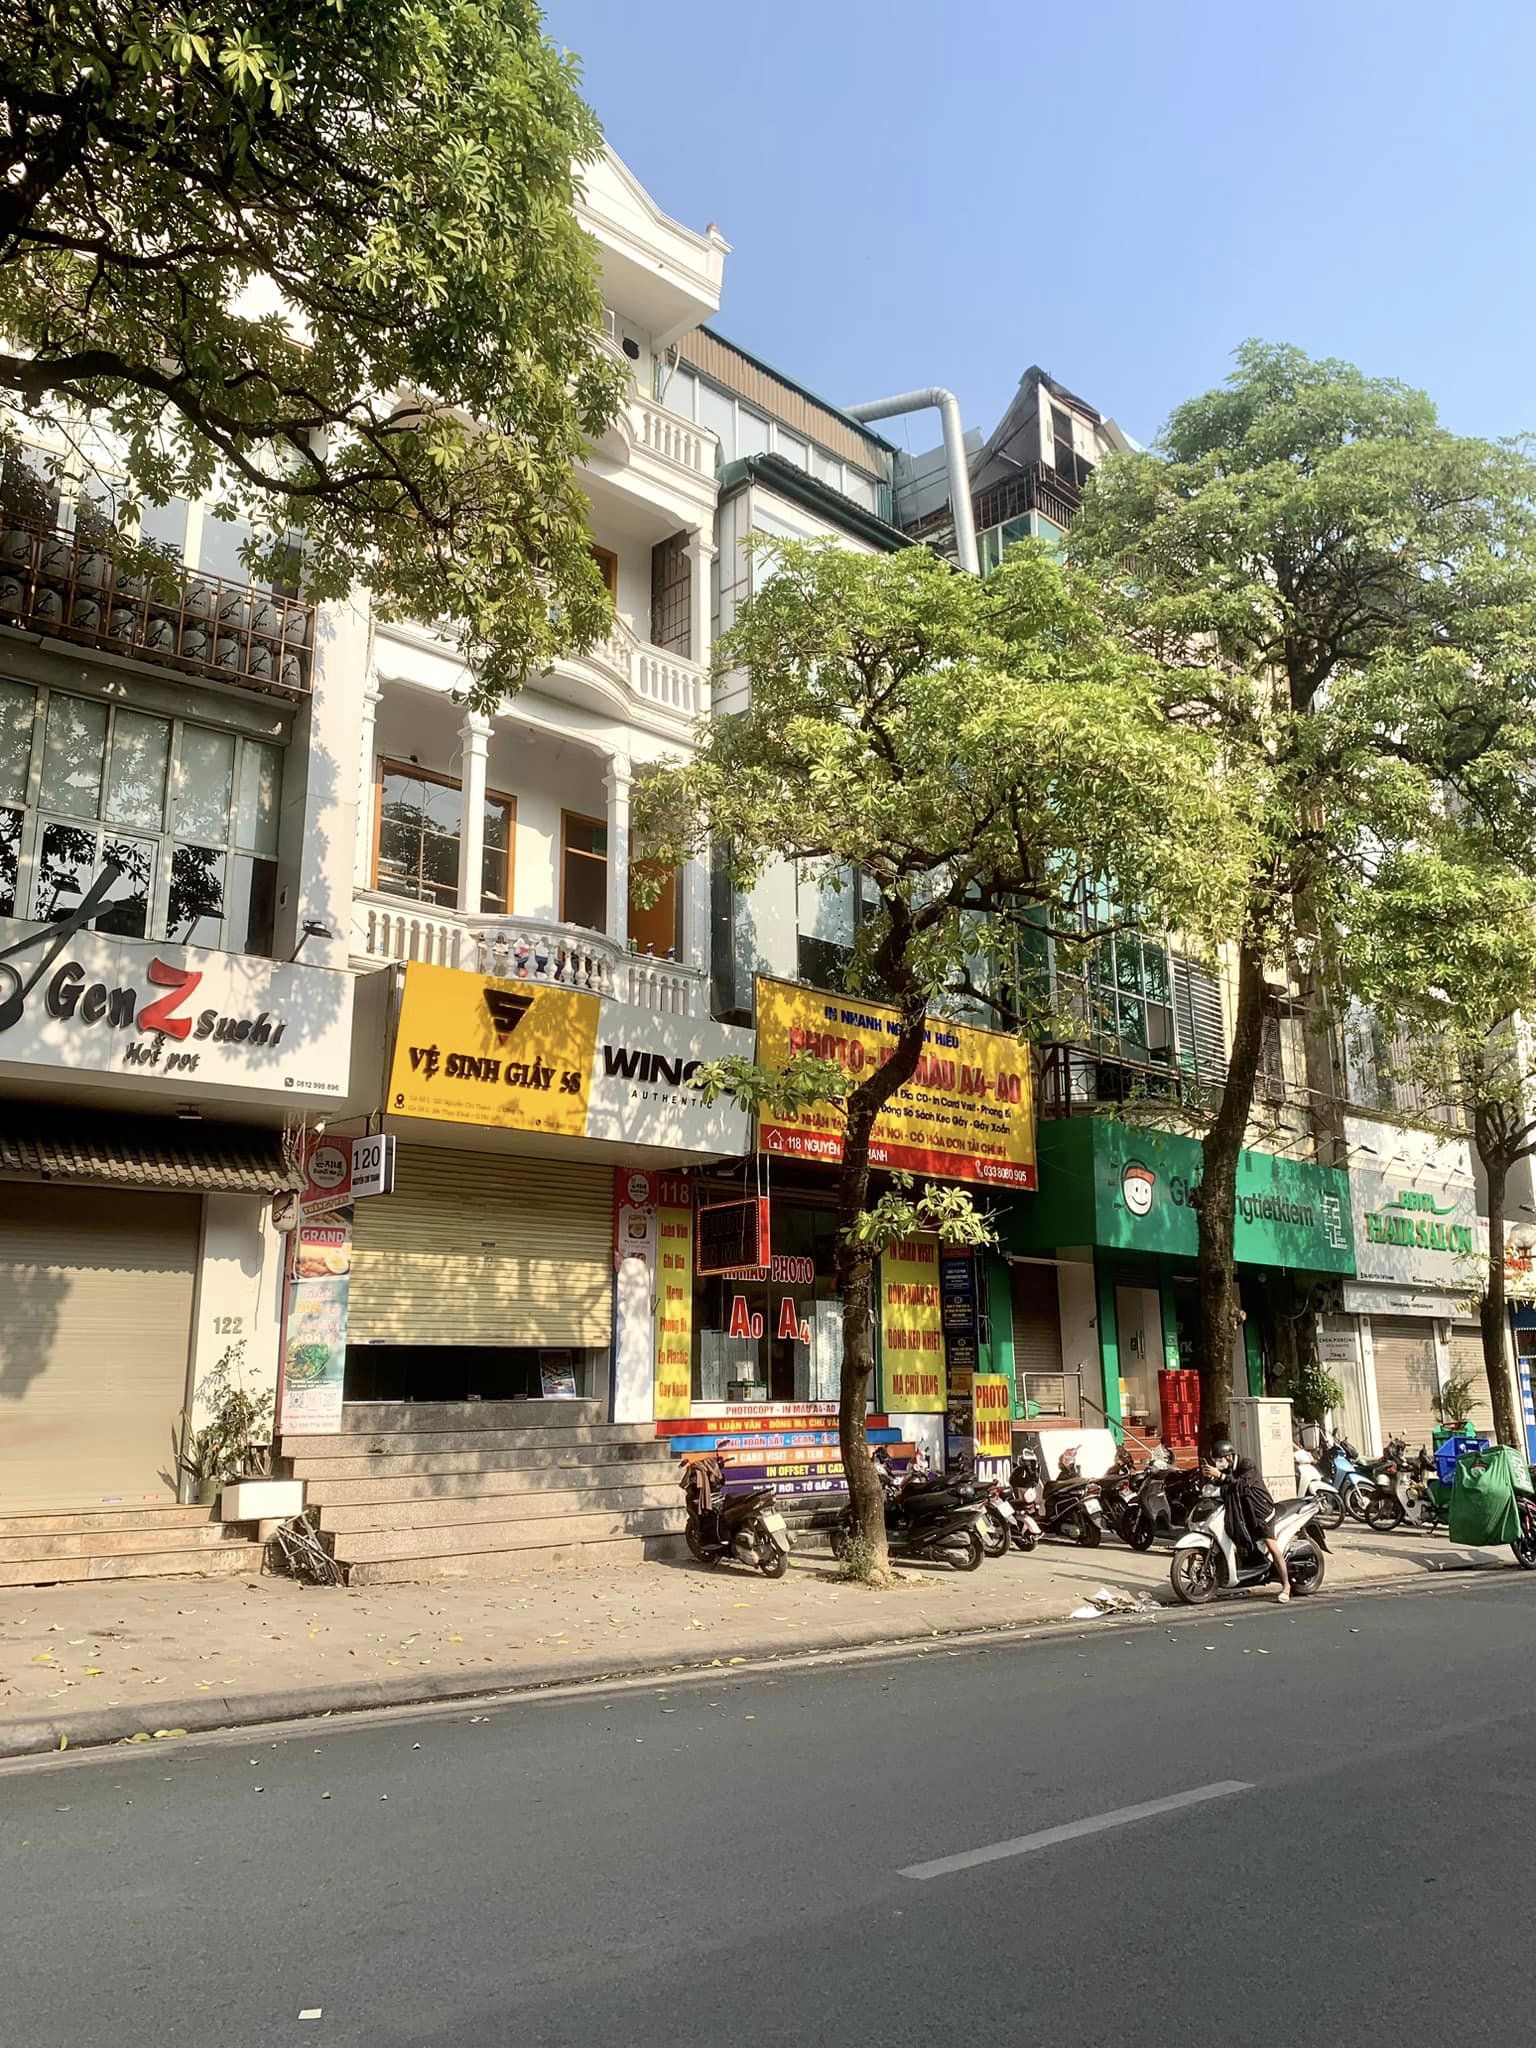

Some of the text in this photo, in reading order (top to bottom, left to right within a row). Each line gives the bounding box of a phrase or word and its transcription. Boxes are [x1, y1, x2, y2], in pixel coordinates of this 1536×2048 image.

[49, 957, 287, 1047] Gen Z Sushi
[824, 1005, 837, 1020] IN
[841, 1009, 883, 1032] NHANH
[123, 1042, 200, 1074] Hot pot
[788, 1026, 864, 1073] PHOTO
[409, 1044, 440, 1082] VỆ
[444, 1053, 502, 1083] SINH
[559, 1071, 582, 1095] 5S
[631, 1089, 713, 1109] AUTHENTIC
[941, 1097, 960, 1109] Card
[981, 1105, 1004, 1119] Phong
[787, 1136, 801, 1149] 118
[910, 1129, 925, 1143] CÓ
[926, 1132, 945, 1147] HÓA
[353, 1146, 380, 1170] 120
[661, 1181, 689, 1204] 118
[301, 1230, 345, 1244] GRAND
[771, 1255, 815, 1285] PHOTO
[213, 1317, 243, 1334] 122
[777, 1297, 812, 1345] A4
[976, 1385, 1008, 1409] PHOTO
[726, 1406, 774, 1416] PHOTOCOPY
[782, 1405, 791, 1415] IN
[707, 1422, 717, 1431] IN
[977, 1420, 987, 1446] IN
[767, 1466, 776, 1477] IN
[779, 1465, 809, 1477] OFFSET
[817, 1463, 826, 1474] IN
